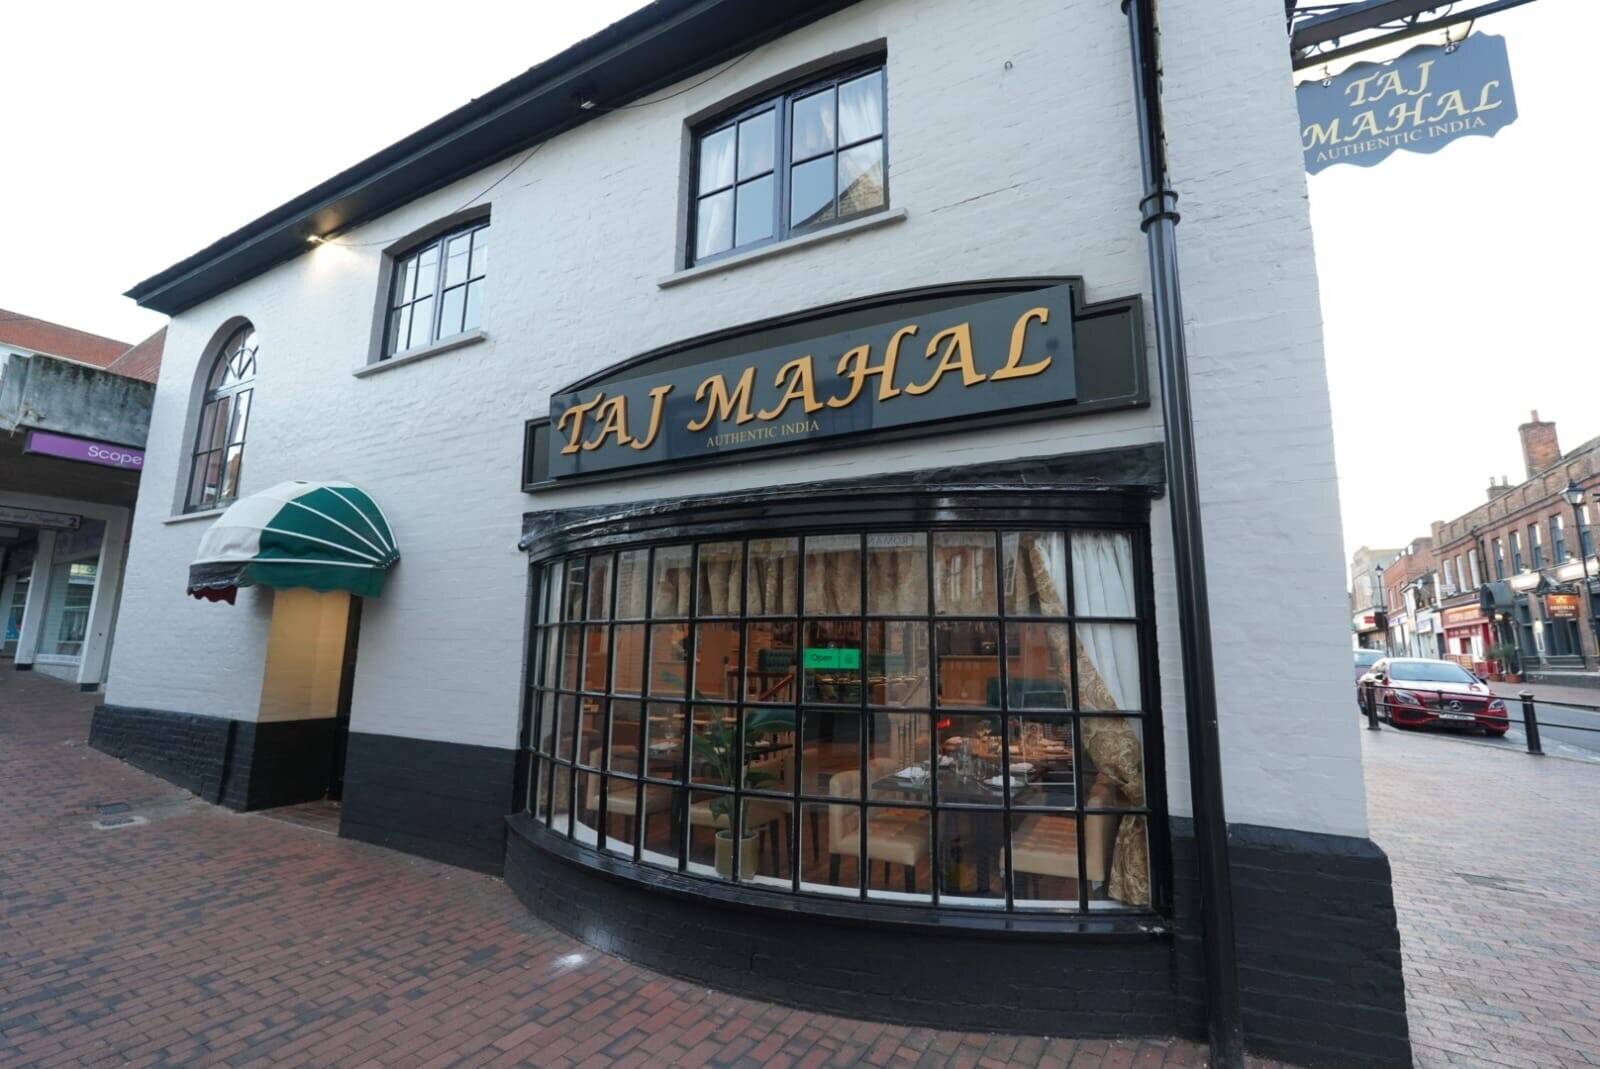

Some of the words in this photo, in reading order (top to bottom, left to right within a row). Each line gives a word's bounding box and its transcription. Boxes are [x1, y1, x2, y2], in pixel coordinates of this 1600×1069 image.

[1344, 60, 1436, 107] TAJ
[1302, 80, 1503, 151] MAHAL
[1316, 129, 1422, 162] AUTHENTIC
[1427, 116, 1487, 138] INDIA
[556, 384, 675, 455] TAJ
[686, 306, 1052, 432] MAHAL
[87, 445, 142, 464] Scope
[706, 424, 778, 448] AUTHENTIC
[780, 419, 820, 437] INDIA
[811, 653, 833, 663] Open
